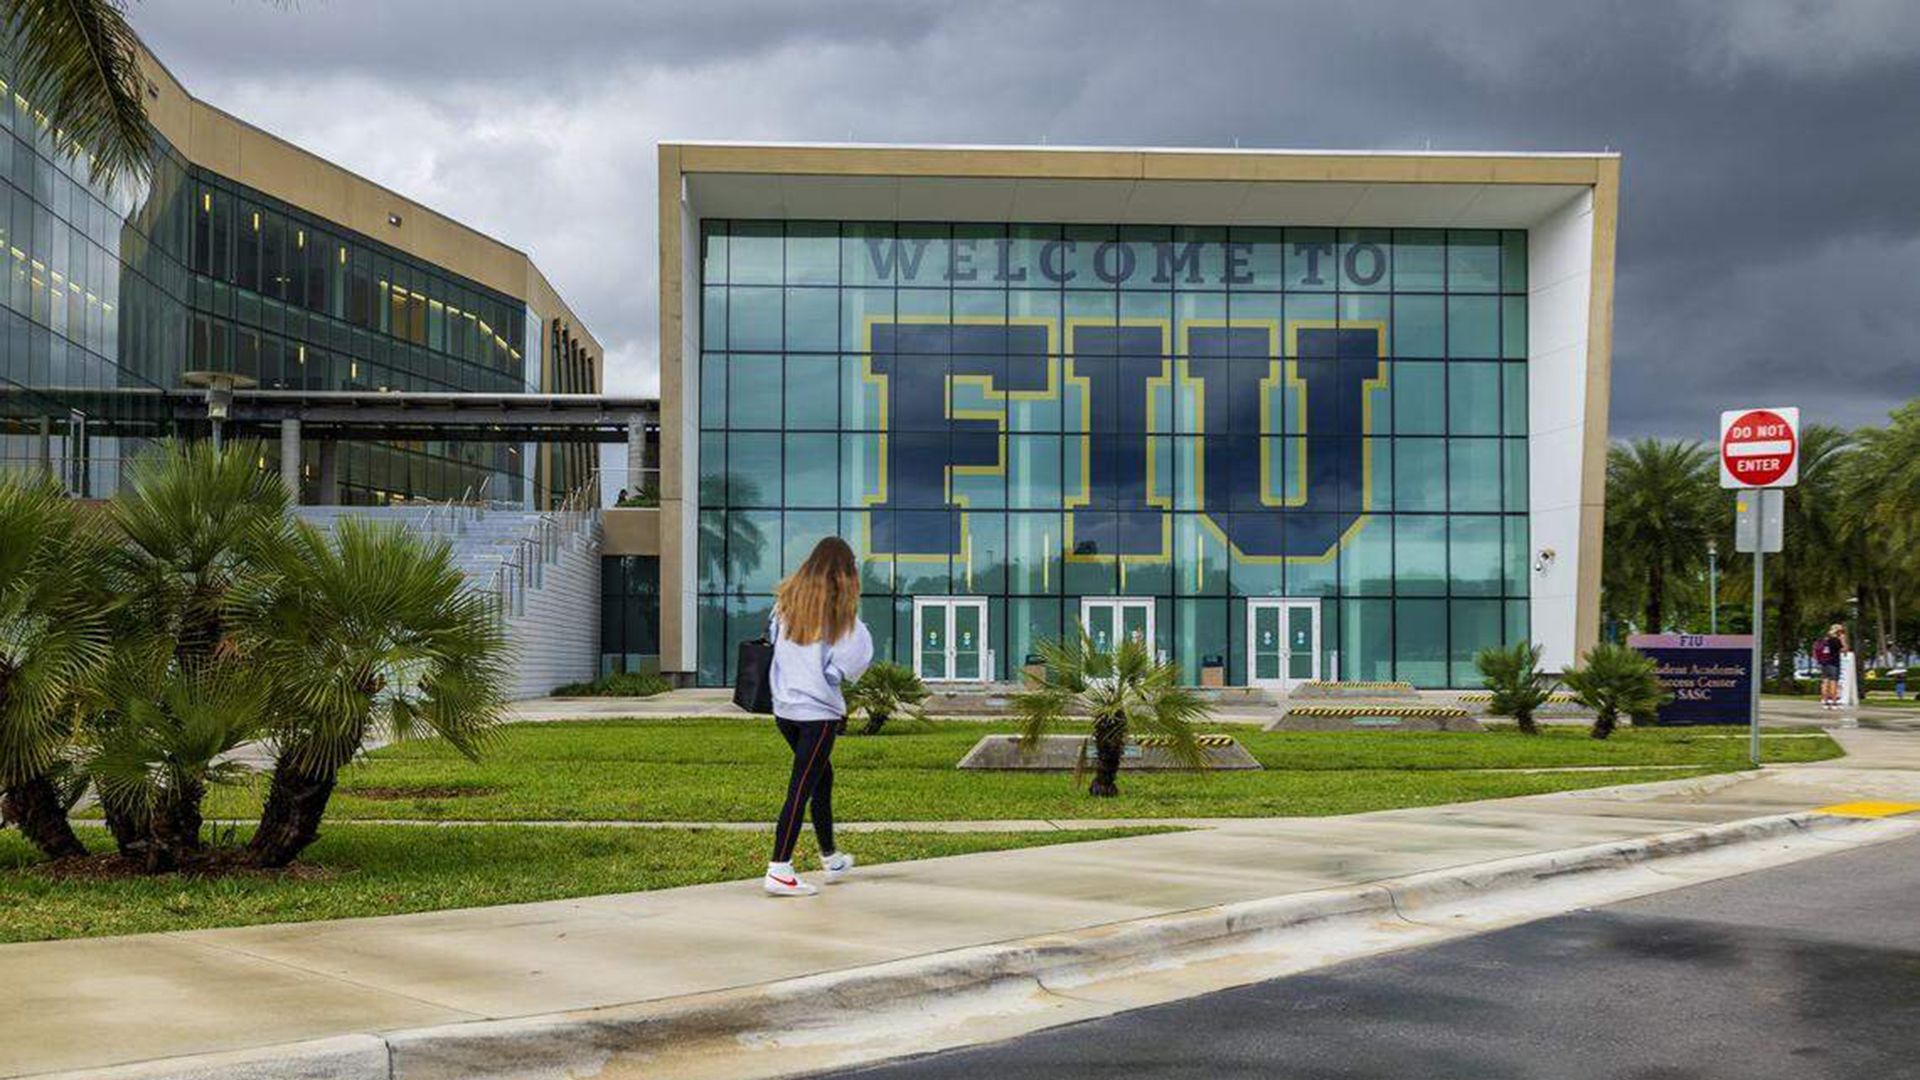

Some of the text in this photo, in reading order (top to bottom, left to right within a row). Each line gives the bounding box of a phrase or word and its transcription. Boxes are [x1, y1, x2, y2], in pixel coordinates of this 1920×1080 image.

[864, 238, 1386, 286] WELCOME TO
[1733, 424, 1786, 439] DO NOT
[862, 315, 1387, 565] FIU
[1737, 458, 1781, 473] ENTER
[1680, 635, 1703, 647] FIU
[1649, 662, 1746, 675] udent Academic
[1697, 676, 1737, 688] Center
[1677, 688, 1712, 700] SASC
